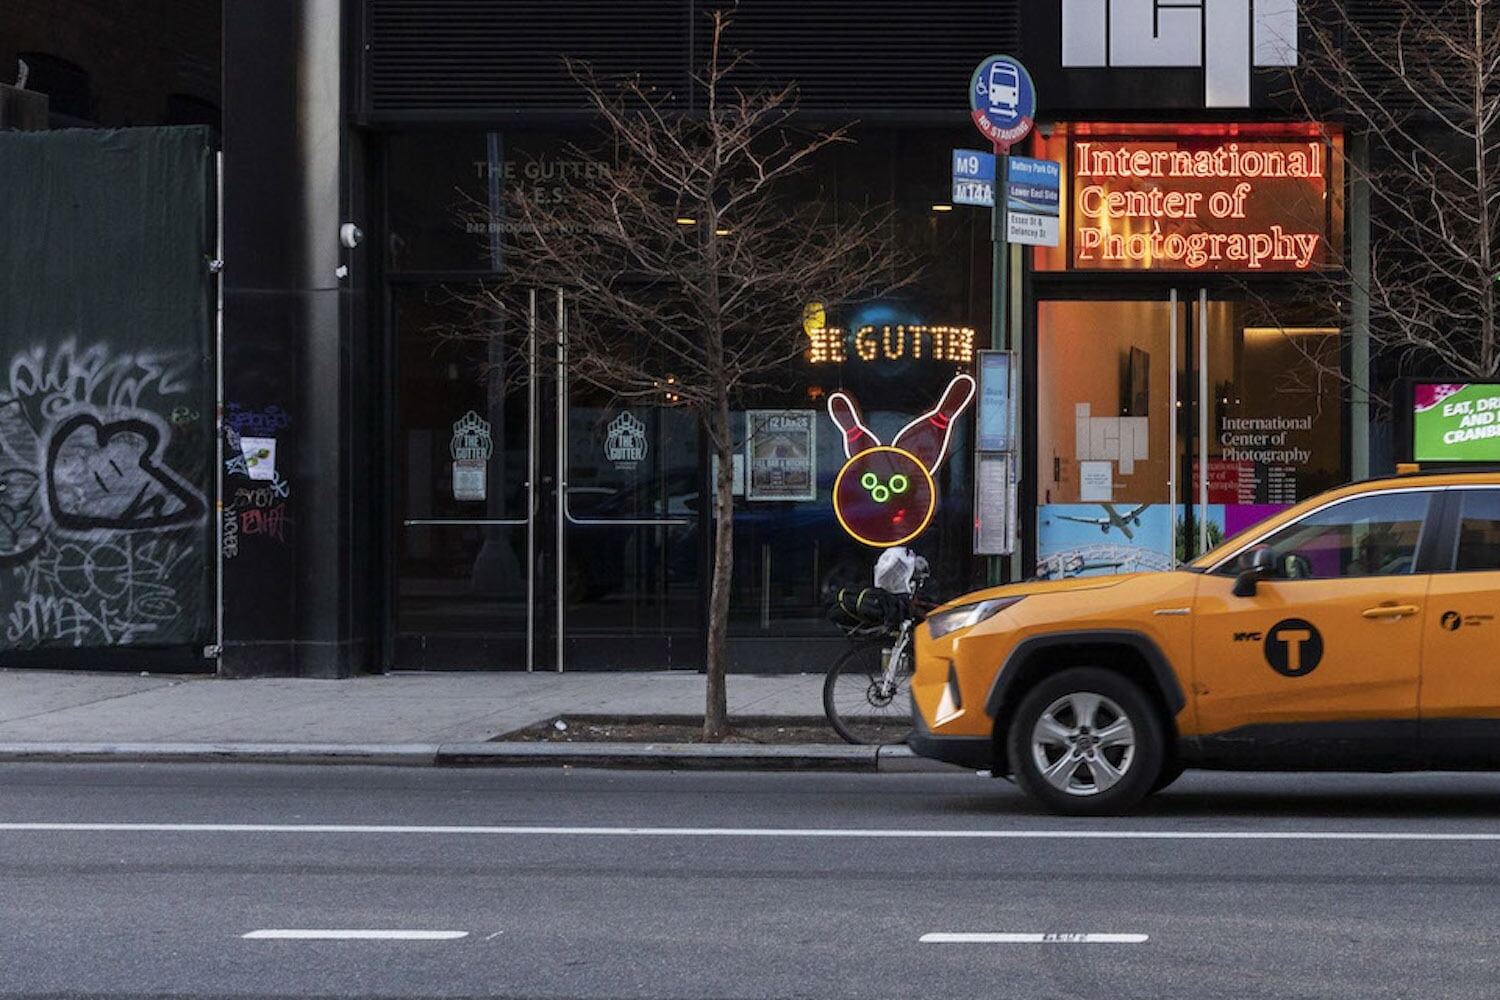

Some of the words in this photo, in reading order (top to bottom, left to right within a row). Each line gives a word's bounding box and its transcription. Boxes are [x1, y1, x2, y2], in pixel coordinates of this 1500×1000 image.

[978, 114, 991, 131] NO
[990, 120, 1029, 140] STANDING
[957, 157, 979, 175] M9
[1077, 144, 1323, 177] International
[474, 162, 517, 179] THE
[525, 162, 612, 179] GUTTER
[1011, 161, 1031, 173] Battery
[1033, 164, 1046, 174] Park
[1047, 166, 1058, 177] City
[1011, 186, 1030, 197] Lower
[1031, 188, 1044, 199] East
[1045, 191, 1058, 200] Side
[1079, 187, 1202, 217] Center
[1209, 184, 1251, 217] of
[1011, 215, 1028, 225] Essex
[1030, 217, 1037, 226] St
[1038, 218, 1043, 227] &
[1011, 227, 1038, 239] Delancey
[1040, 229, 1047, 238] St
[1079, 226, 1319, 267] Photography
[1443, 401, 1473, 417] EAT,
[1221, 417, 1311, 430] International
[1459, 413, 1493, 428] AND
[463, 435, 480, 447] THE
[617, 435, 635, 447] THE
[1075, 403, 1149, 475] icp
[1220, 432, 1267, 446] Center
[1269, 432, 1285, 445] of
[453, 448, 487, 460] GUTTER
[607, 448, 641, 460] GUTTER
[1221, 448, 1311, 463] Photography
[1233, 632, 1262, 641] NYC
